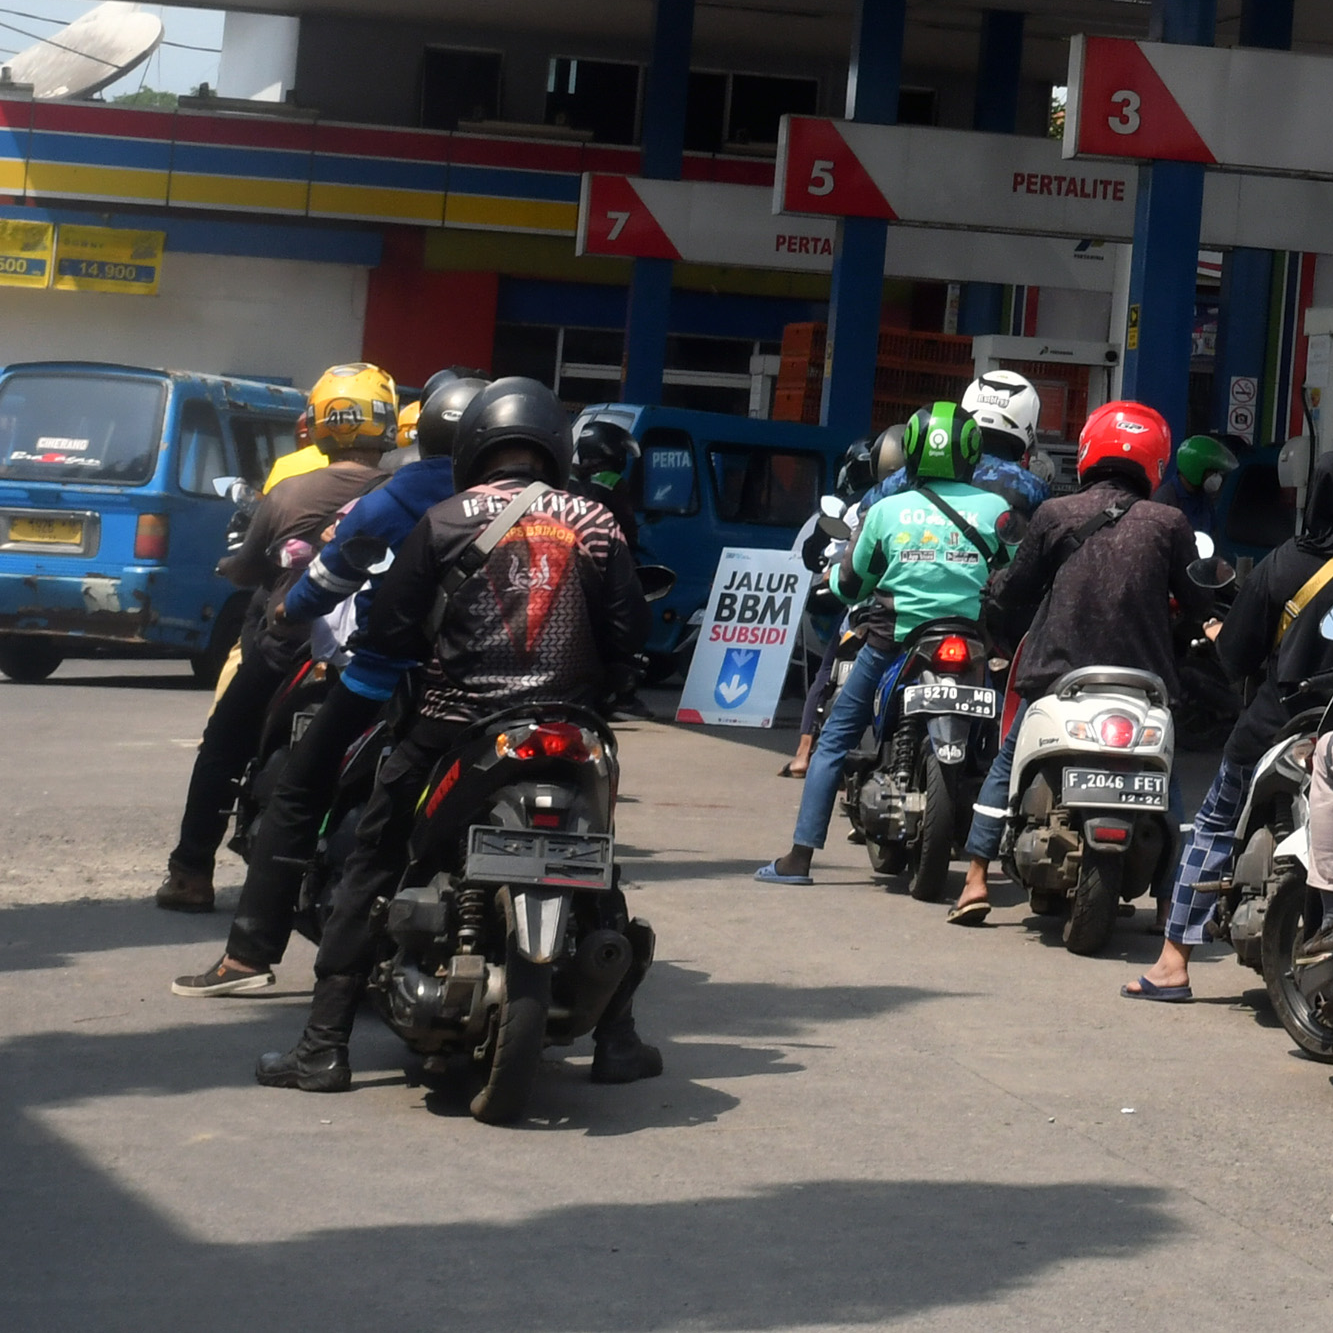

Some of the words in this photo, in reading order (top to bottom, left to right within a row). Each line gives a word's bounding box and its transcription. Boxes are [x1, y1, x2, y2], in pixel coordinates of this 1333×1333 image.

[1108, 90, 1141, 135] 3
[807, 160, 835, 196] 5
[1012, 172, 1125, 201] PERTALITE
[606, 212, 630, 241] 7
[80, 262, 136, 280] 14.900
[526, 524, 575, 544] BRIMOB
[724, 570, 799, 594] JALUR
[714, 592, 793, 626] BBM
[709, 624, 788, 645] SUBSIDI
[924, 687, 957, 700] 5270
[1069, 773, 1078, 787] F
[1087, 774, 1125, 789] 2046
[1134, 776, 1163, 793] FET
